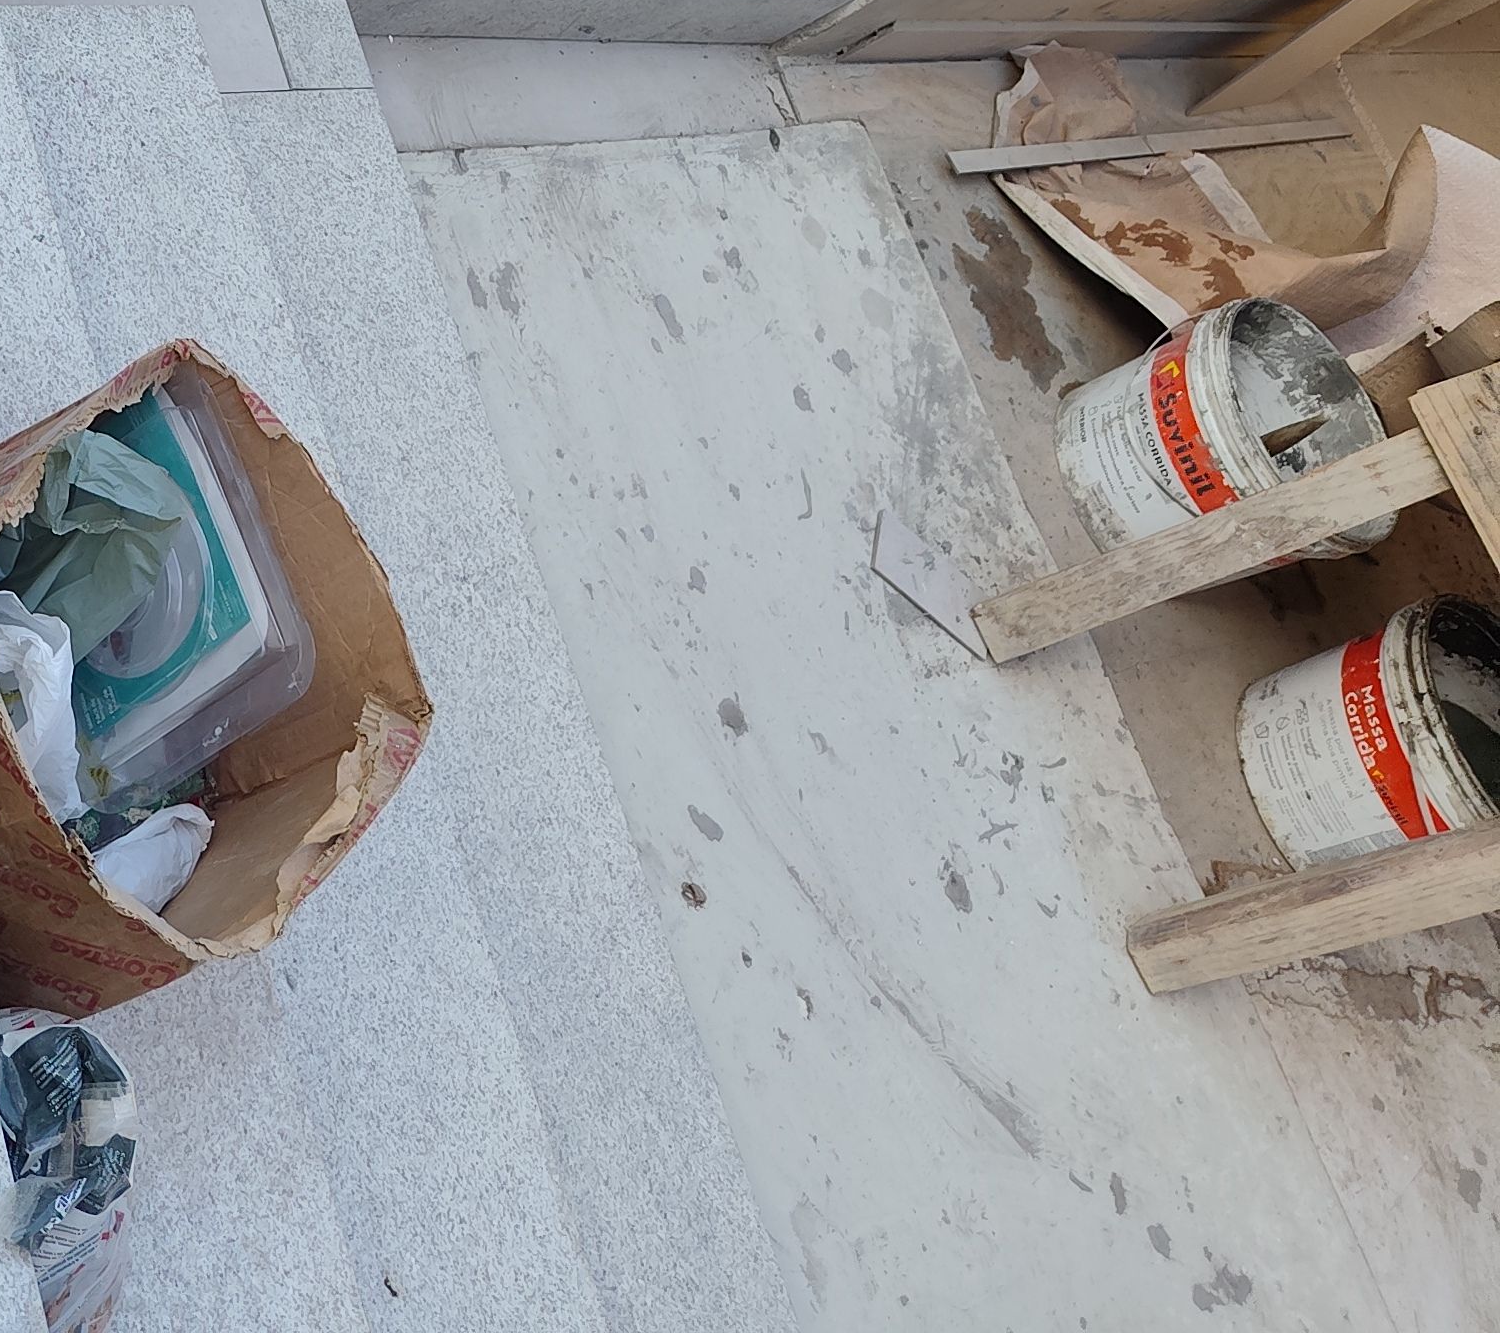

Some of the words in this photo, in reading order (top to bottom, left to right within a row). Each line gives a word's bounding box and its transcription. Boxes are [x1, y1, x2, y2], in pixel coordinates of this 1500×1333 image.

[1137, 391, 1150, 430] MASSA
[1145, 431, 1172, 487] CORRIDA
[1158, 392, 1215, 497] Suvinil
[1344, 691, 1377, 770] Corrida
[1360, 684, 1388, 752] Massa
[50, 938, 177, 990] CORTAG
